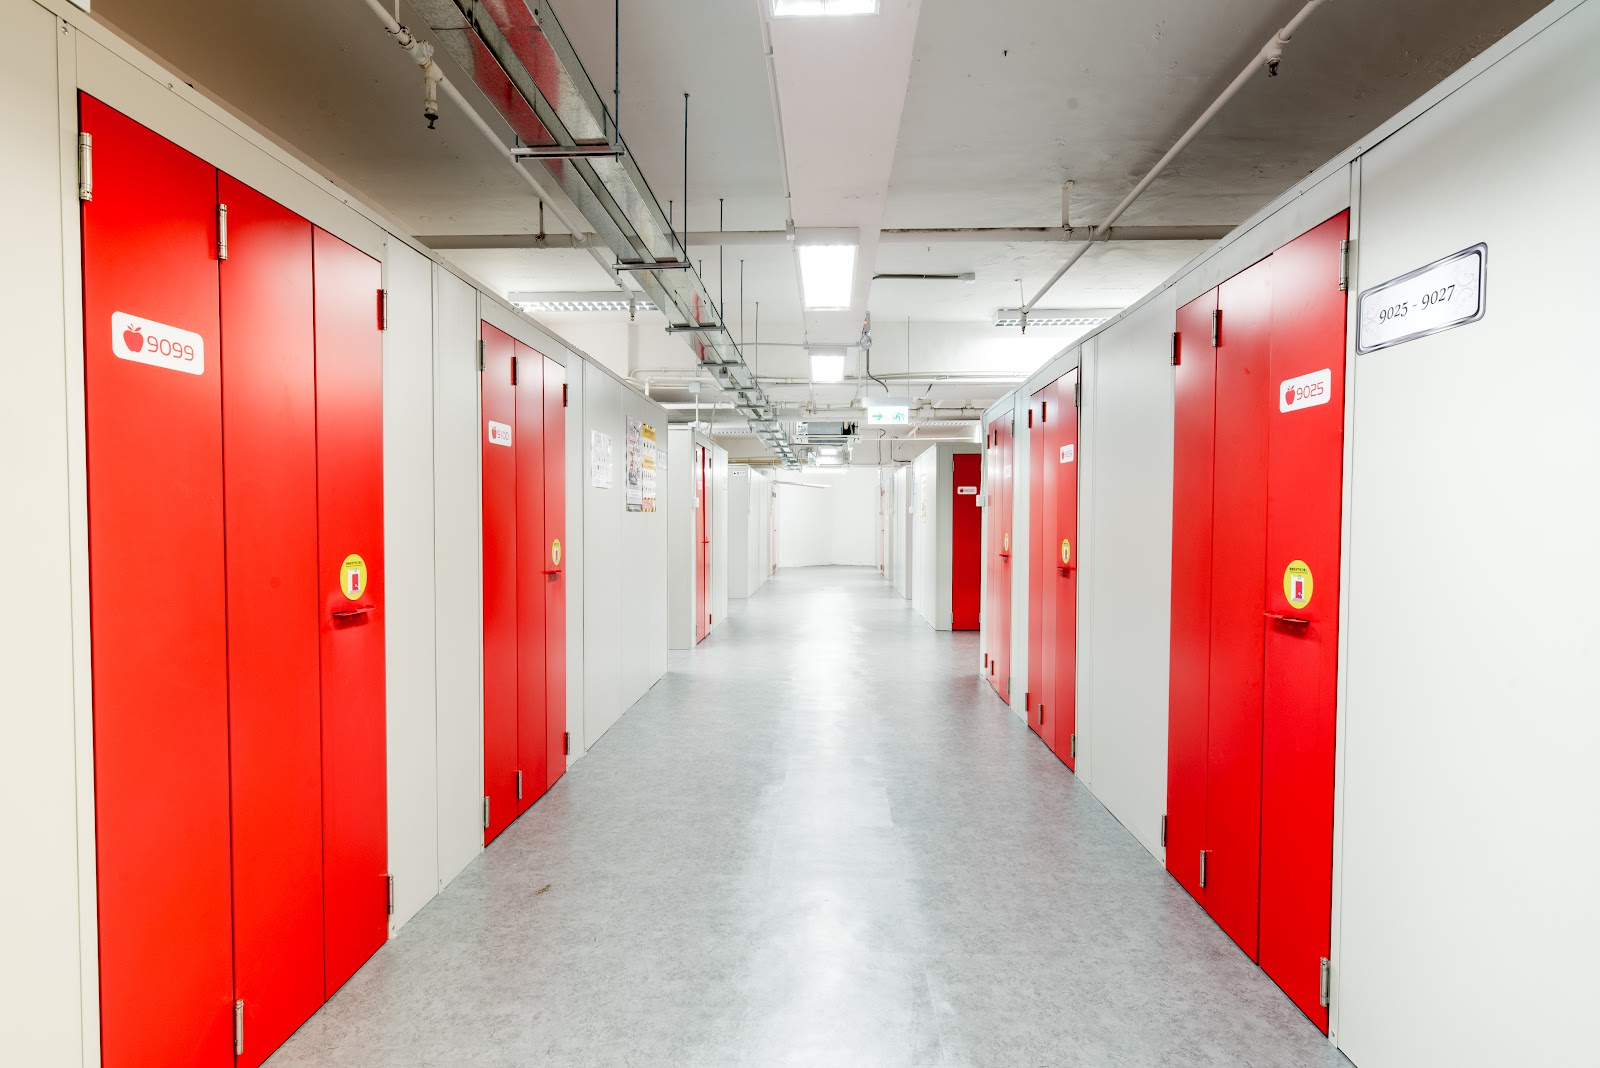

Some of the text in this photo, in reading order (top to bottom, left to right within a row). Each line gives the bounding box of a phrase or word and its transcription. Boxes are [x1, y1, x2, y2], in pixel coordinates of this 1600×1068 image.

[1379, 301, 1409, 325] 9025
[1421, 284, 1456, 311] 9027
[146, 335, 194, 362] 9099
[1296, 381, 1324, 401] 9025
